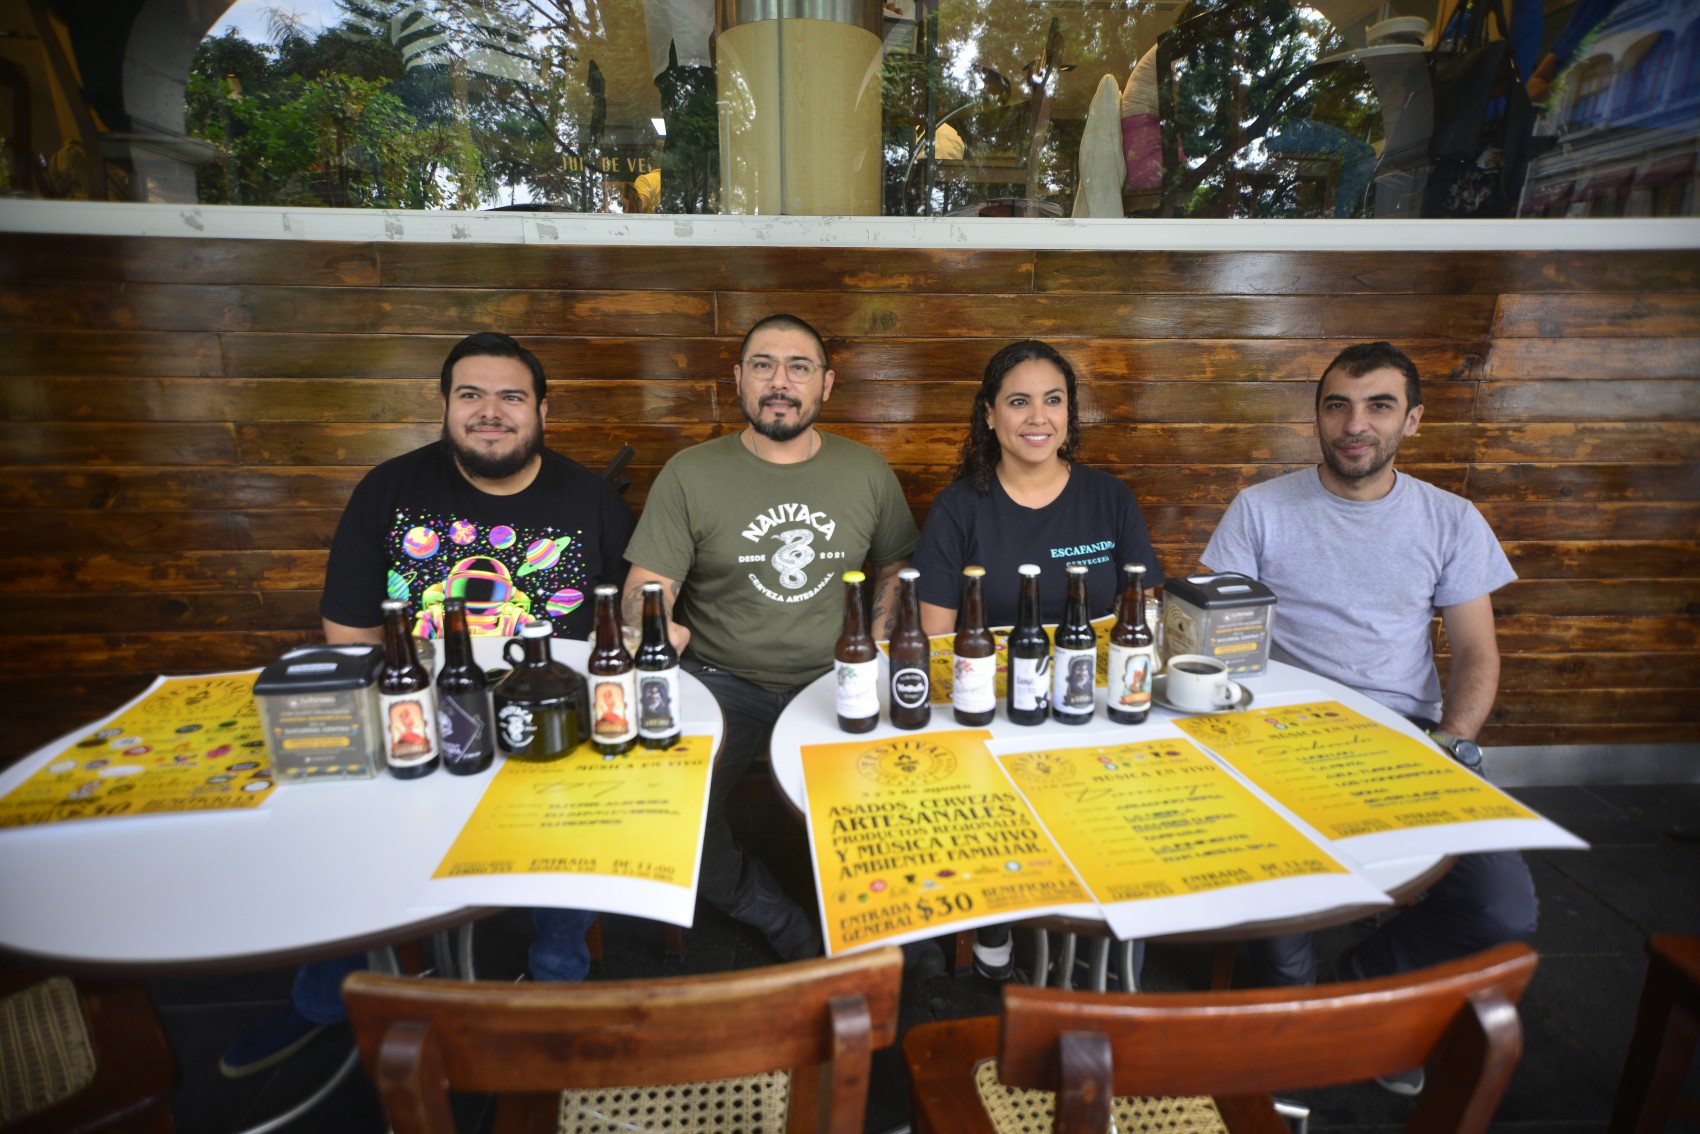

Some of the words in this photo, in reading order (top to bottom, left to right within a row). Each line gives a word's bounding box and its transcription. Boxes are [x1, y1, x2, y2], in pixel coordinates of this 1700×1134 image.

[601, 156, 620, 173] DE
[741, 503, 836, 543] NAUYACA
[738, 555, 766, 563] DESDE
[819, 552, 845, 560] 2021
[748, 573, 785, 603] CERVEZA
[785, 571, 835, 603] ARTESANAL
[919, 792, 1016, 809] CERVEZAS
[832, 803, 1025, 835] ARTESANALES,
[832, 826, 928, 847] PRODUCTOS
[932, 817, 1032, 835] REGIONALES
[836, 849, 849, 864] Y
[950, 834, 981, 848] EN
[985, 828, 1039, 844] VIVO
[839, 852, 943, 881] AMBIENTE
[840, 903, 912, 931] ENTRADA
[916, 891, 974, 922] $30
[841, 917, 914, 944] GENERAL
